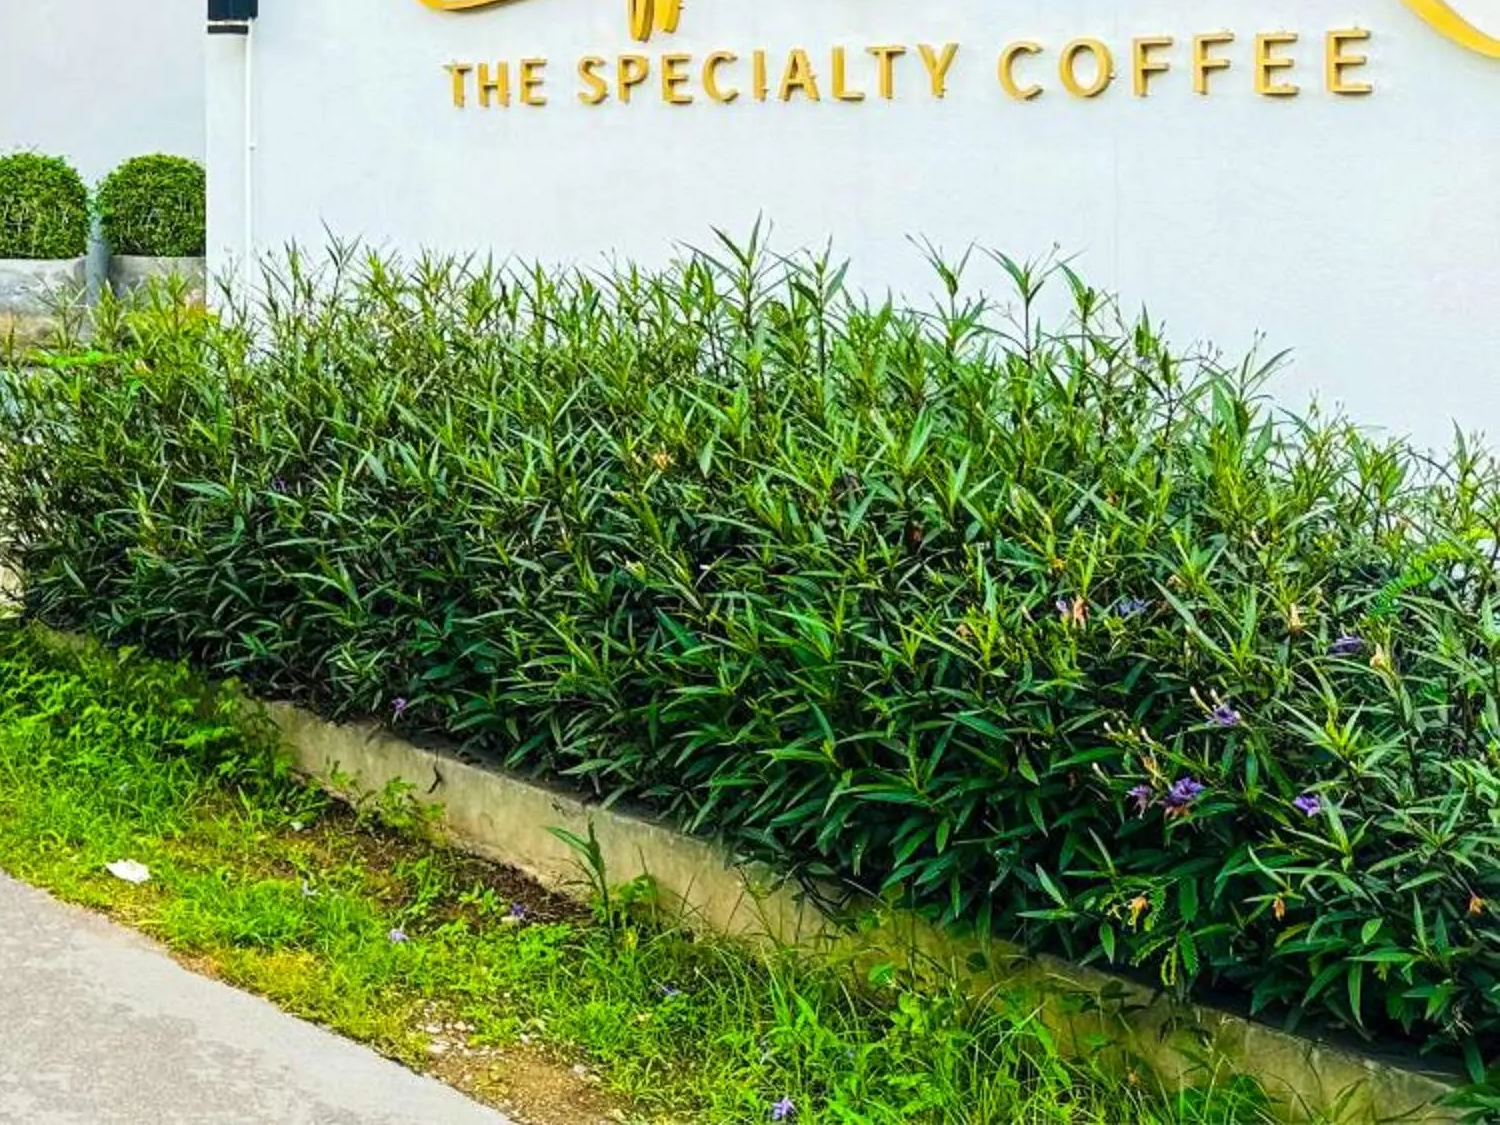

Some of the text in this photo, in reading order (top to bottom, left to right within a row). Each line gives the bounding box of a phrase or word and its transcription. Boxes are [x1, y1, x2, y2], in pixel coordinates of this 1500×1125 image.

[443, 26, 1374, 108] THE SPECIALTY COFFEE
